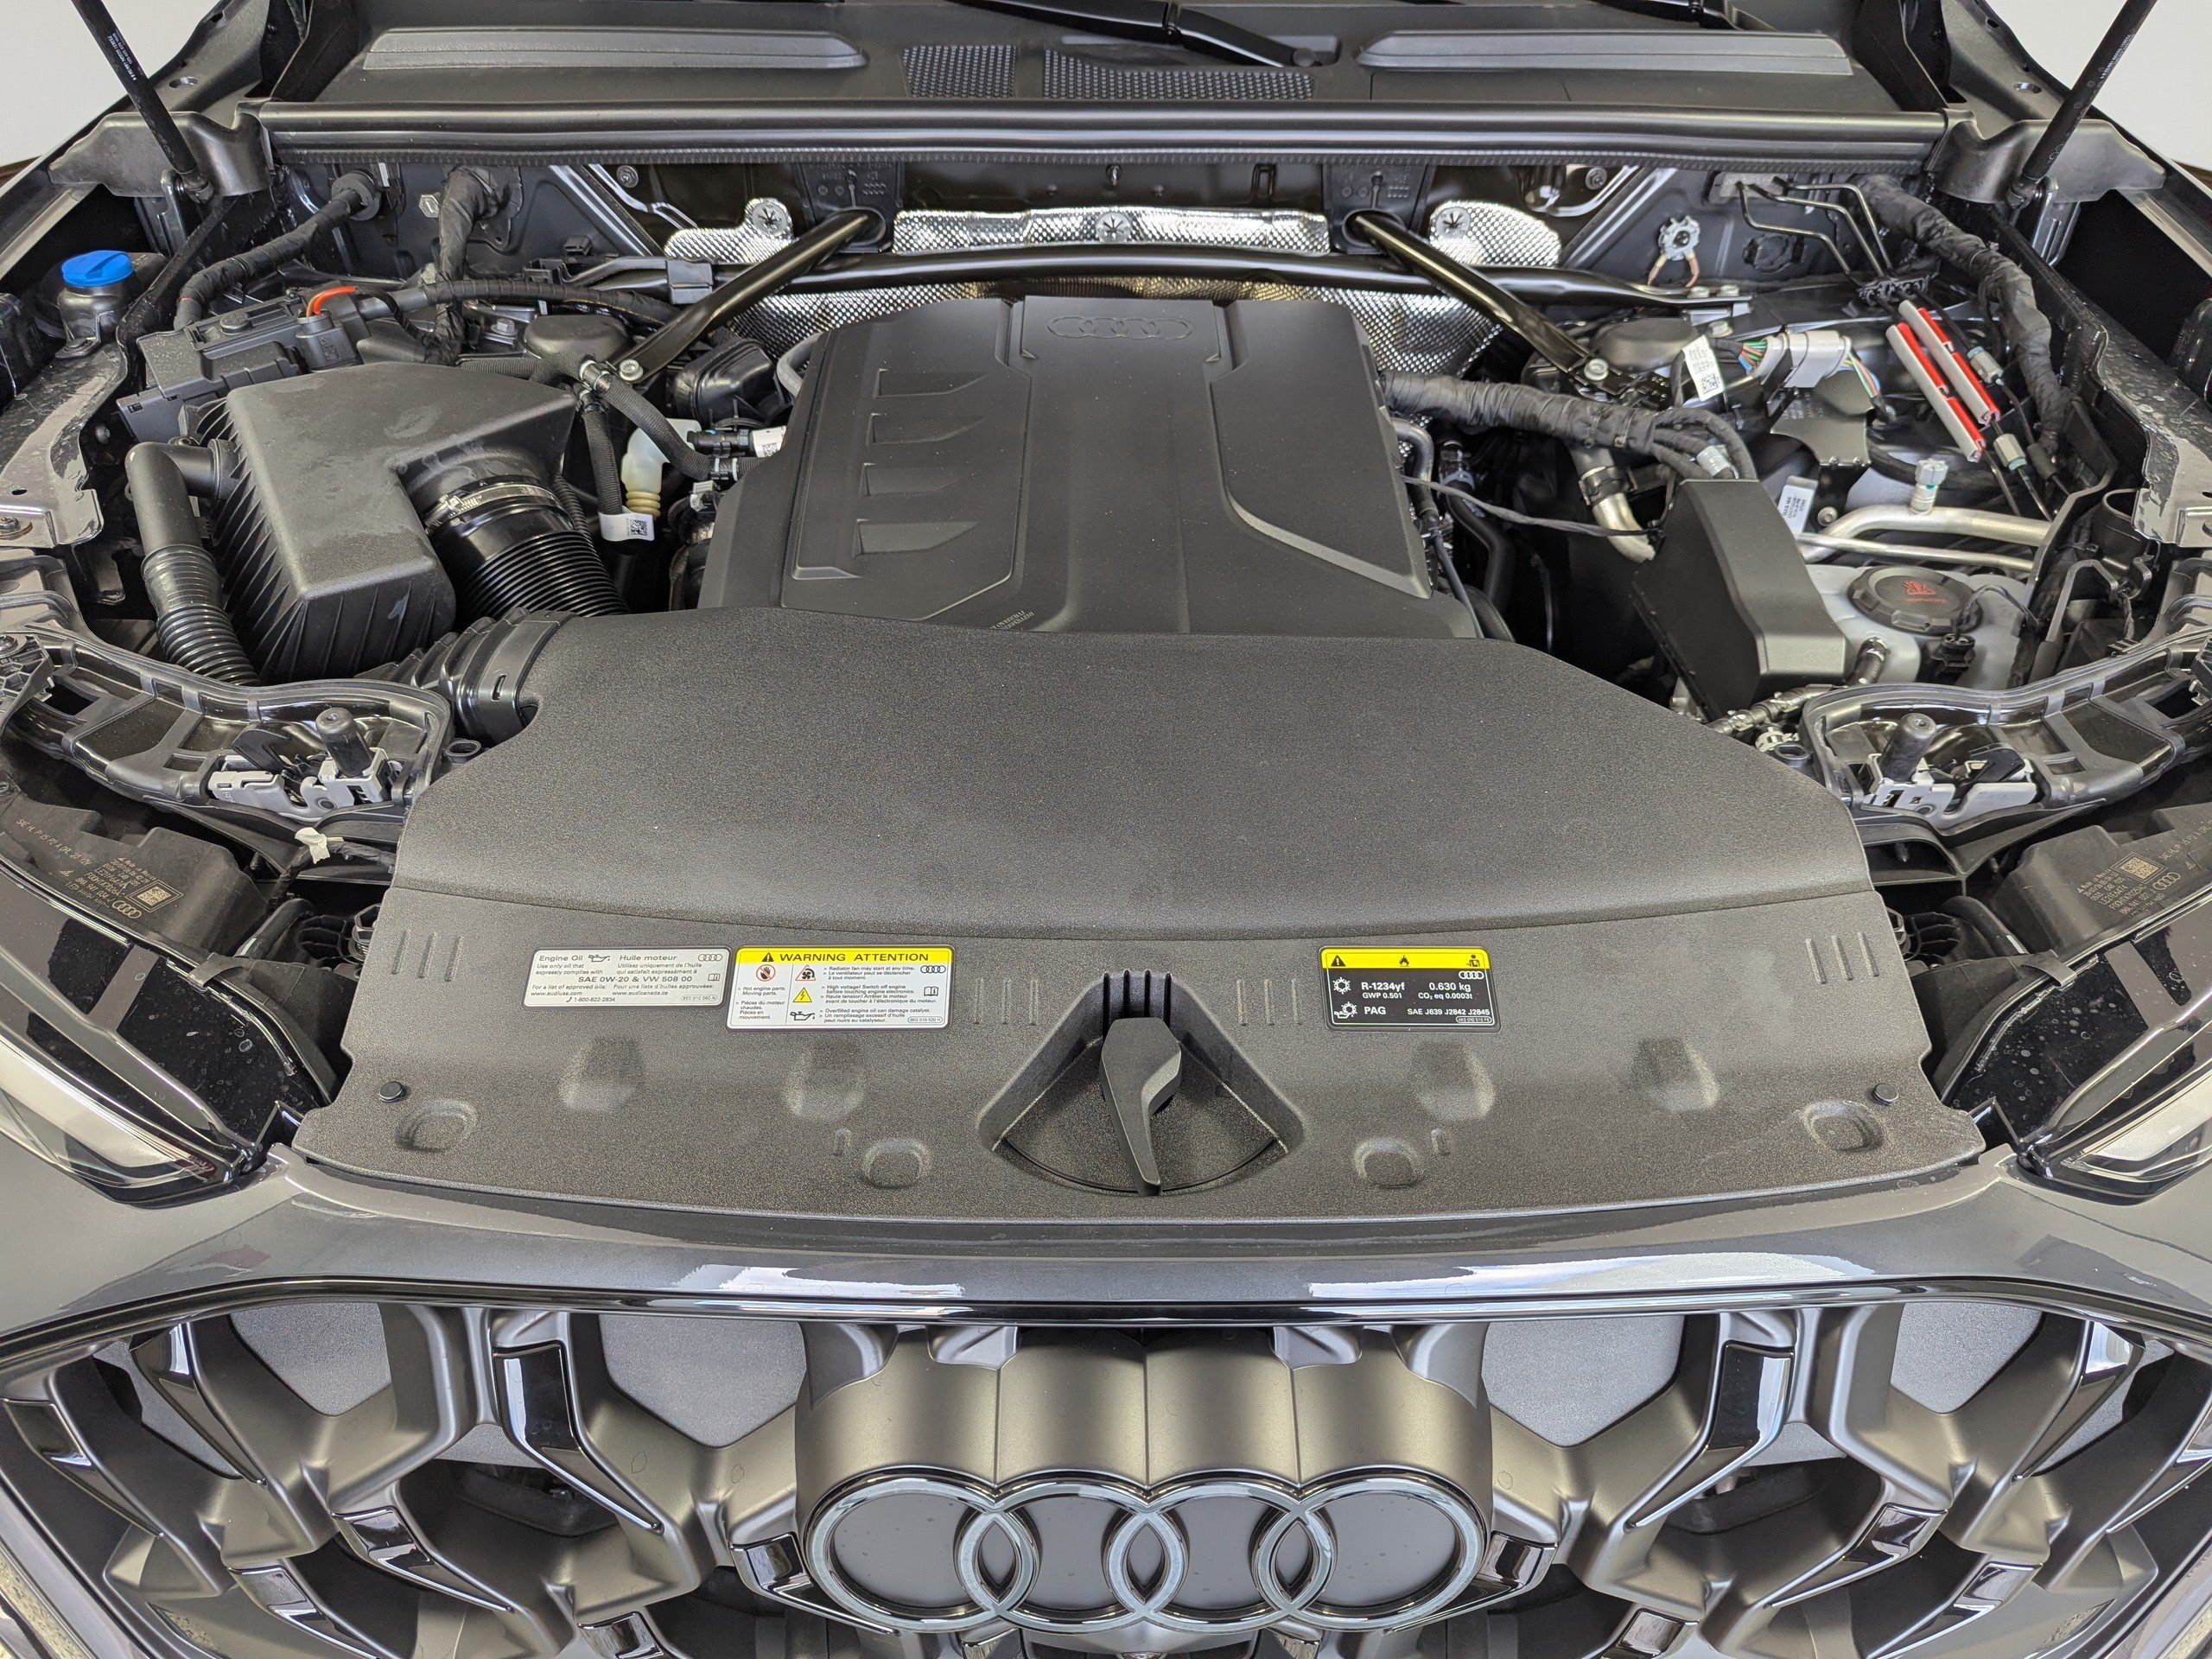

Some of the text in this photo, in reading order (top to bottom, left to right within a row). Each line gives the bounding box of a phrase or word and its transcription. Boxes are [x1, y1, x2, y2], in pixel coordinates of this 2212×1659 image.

[780, 953, 928, 961] WARNING ATTENTION
[1361, 982, 1405, 992] R-1234yf
[1429, 982, 1471, 992] 0.630 kg
[1364, 1007, 1386, 1015] PAG
